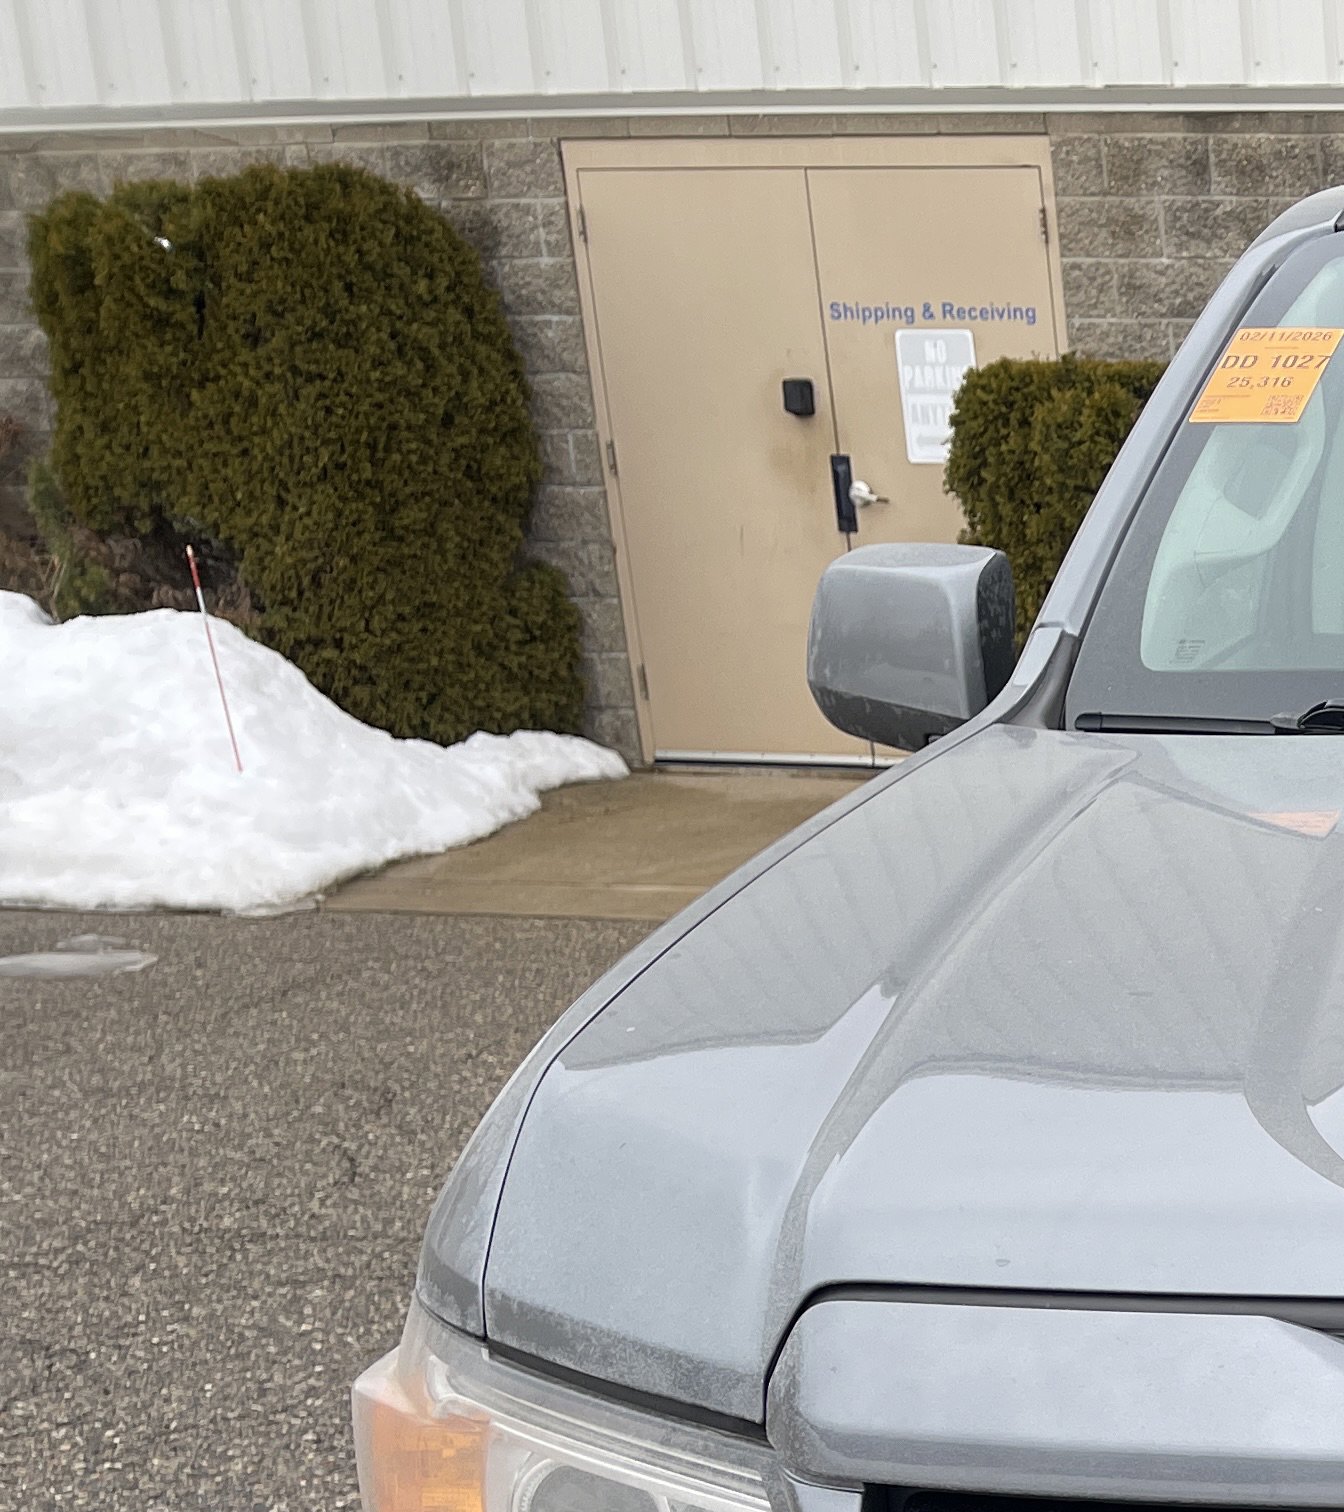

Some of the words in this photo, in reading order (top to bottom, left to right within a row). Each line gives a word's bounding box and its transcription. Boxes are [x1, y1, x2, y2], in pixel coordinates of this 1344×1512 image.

[829, 301, 916, 325] Shipping
[921, 302, 936, 321] &
[941, 302, 1037, 326] Receiving
[1239, 331, 1333, 342] 02/11/2026
[924, 338, 947, 364] NO
[1221, 355, 1258, 370] DD
[1271, 355, 1332, 370] 1027
[903, 364, 968, 390] PARKIN
[1227, 376, 1295, 390] 25,316
